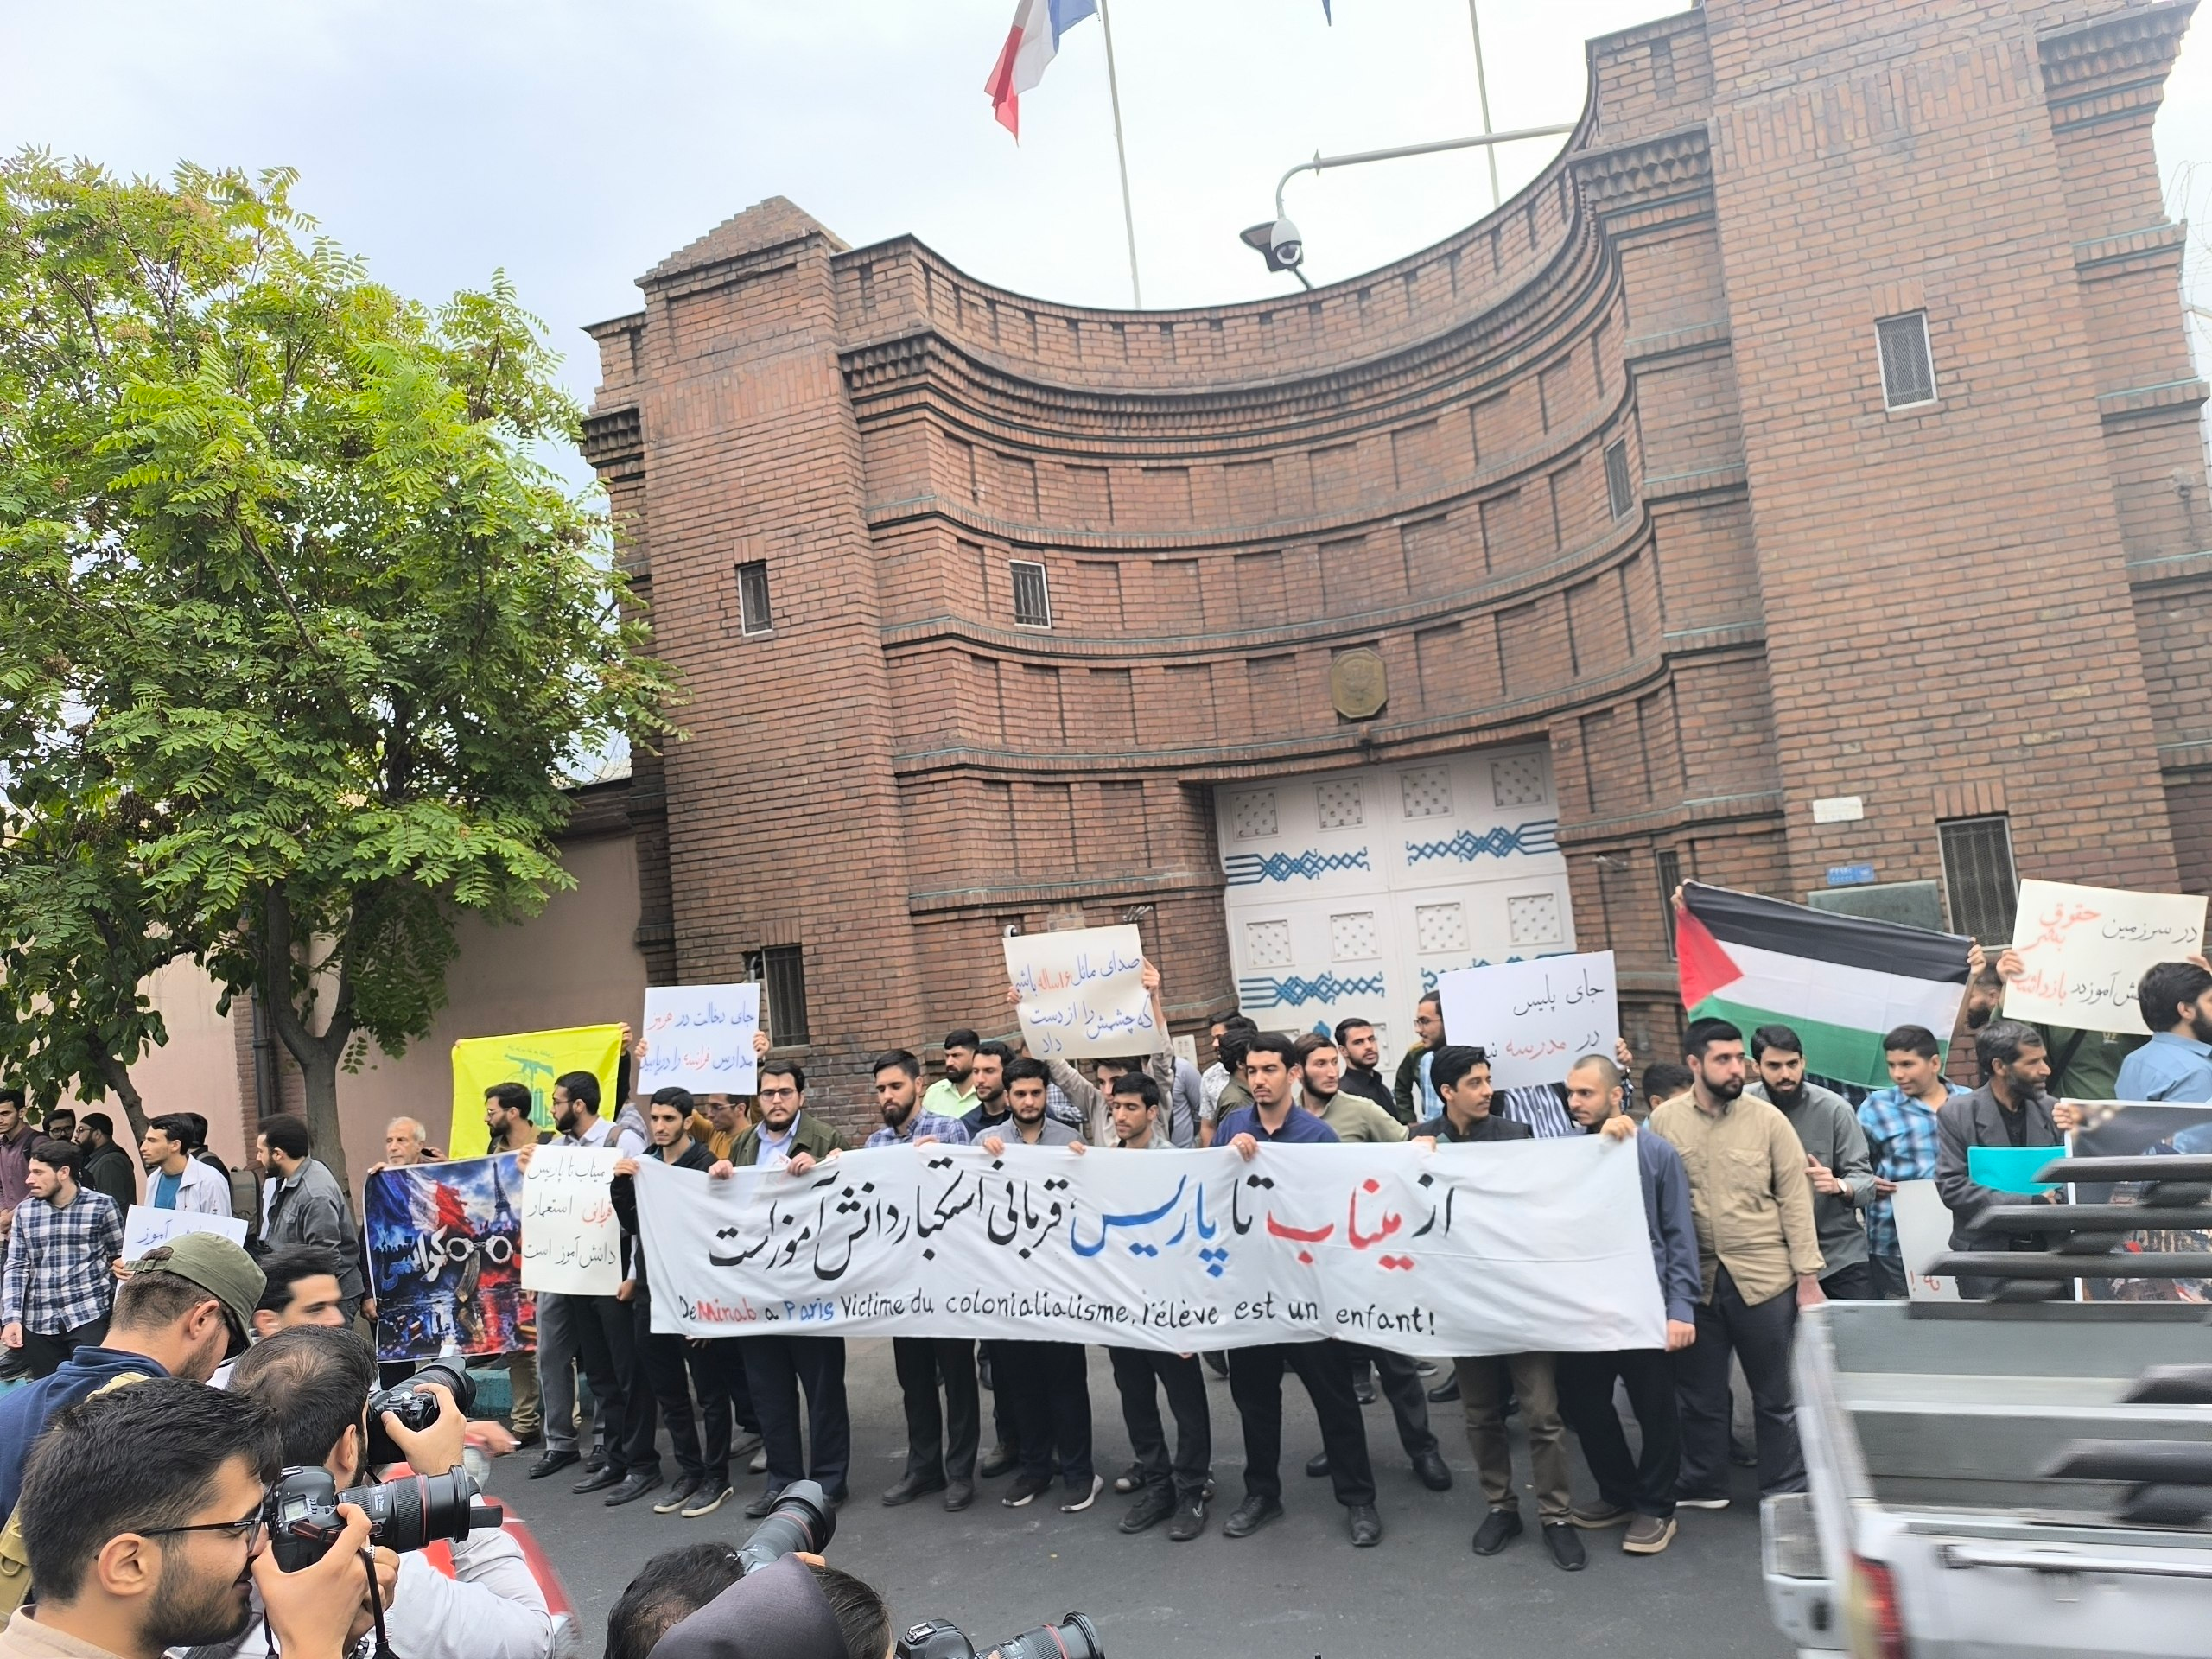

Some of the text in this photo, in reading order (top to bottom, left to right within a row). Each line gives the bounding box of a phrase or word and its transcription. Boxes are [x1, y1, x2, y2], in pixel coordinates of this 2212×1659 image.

[2018, 927, 2066, 951] بشر
[2039, 904, 2198, 944] در سرزمین حقوق
[1100, 950, 1141, 977] صدای
[1513, 968, 1605, 1016] جای پلیس
[675, 1014, 690, 1027] در
[693, 1001, 726, 1027] دخالت
[730, 1000, 754, 1027] جای
[1030, 995, 1154, 1039] که چشمش را از دست
[1042, 1032, 1063, 1053] داد
[1505, 1038, 1567, 1060] مدرسه
[1574, 1030, 1599, 1052] در
[671, 1046, 682, 1071] را
[712, 1045, 753, 1071] مدارس
[527, 1154, 565, 1183] پاریس
[575, 1156, 606, 1183] میناب
[526, 1192, 613, 1228] قربانی استعمار
[766, 1170, 840, 1270] آموز
[892, 1156, 983, 1261] استکبار
[988, 1159, 1069, 1260] قربانی
[1231, 1174, 1274, 1236] تا
[1412, 1173, 1455, 1238] از
[135, 1218, 173, 1246] آموز
[709, 1199, 778, 1267] است
[813, 1181, 899, 1281] دانش
[1266, 1178, 1415, 1271] میناب
[523, 1235, 617, 1268] دانش آموز است
[679, 1294, 697, 1320] De
[697, 1297, 758, 1321] Minab
[765, 1307, 779, 1320] a
[783, 1298, 835, 1321] Paris
[840, 1295, 906, 1319] Victime
[911, 1287, 934, 1314] du
[1233, 1291, 1276, 1319] est
[1287, 1300, 1319, 1320] un
[1336, 1303, 1436, 1336] enfant!
